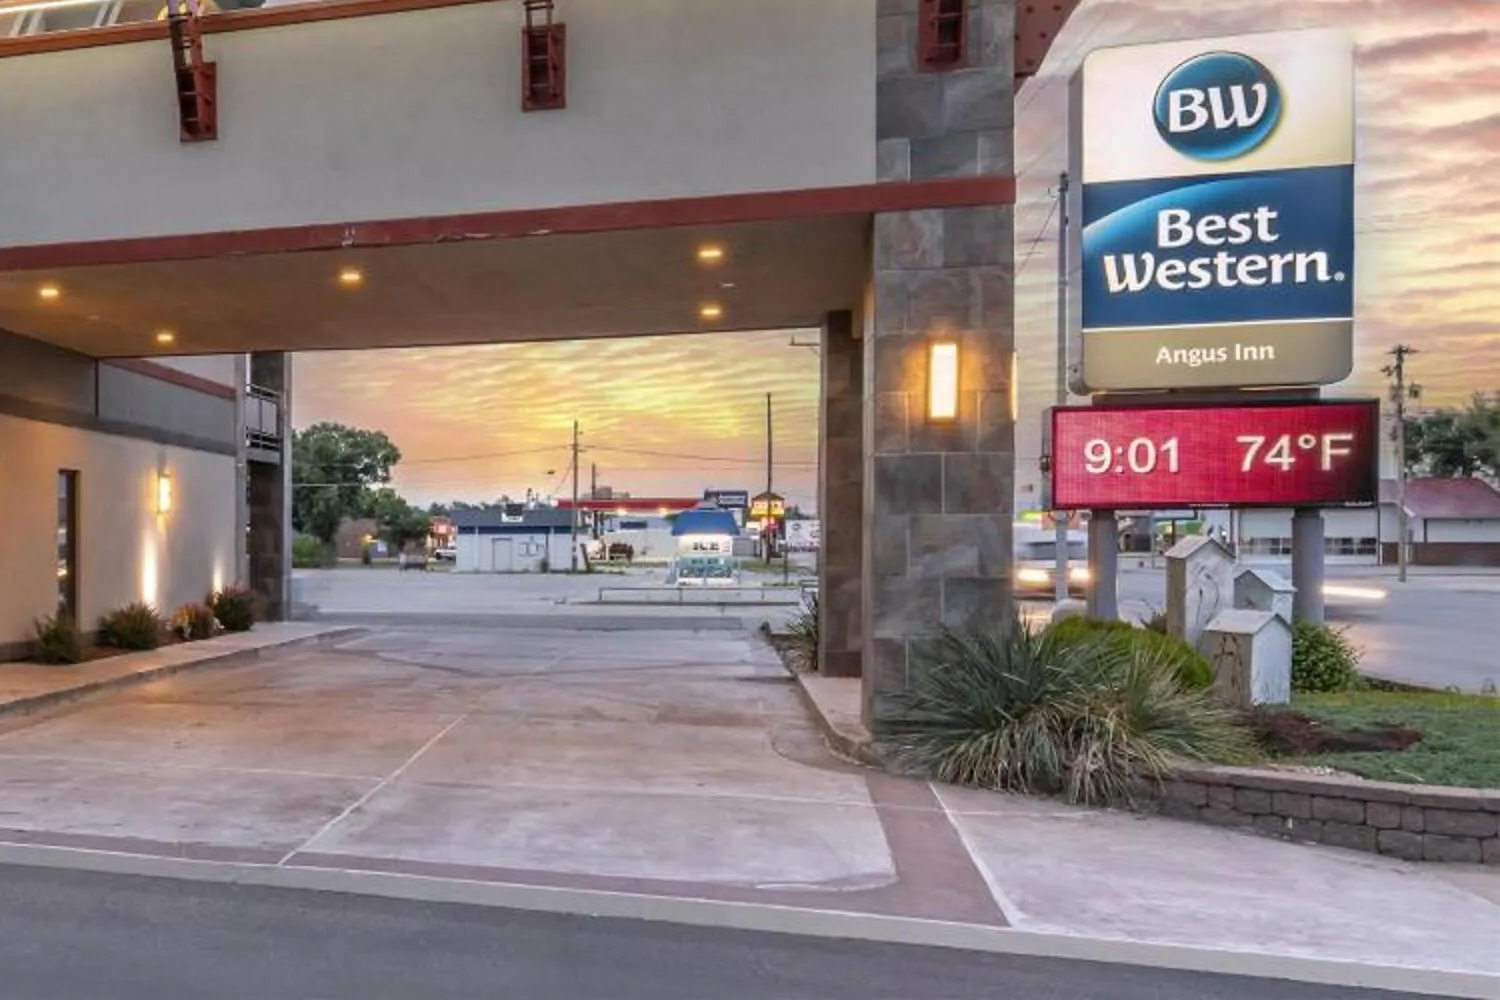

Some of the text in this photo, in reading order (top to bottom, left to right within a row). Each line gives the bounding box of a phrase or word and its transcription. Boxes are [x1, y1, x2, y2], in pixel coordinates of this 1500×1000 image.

[1168, 82, 1268, 133] BW
[1157, 206, 1280, 248] Best
[1155, 343, 1276, 367] Angus Inn
[1083, 432, 1354, 473] 9:01 74°F
